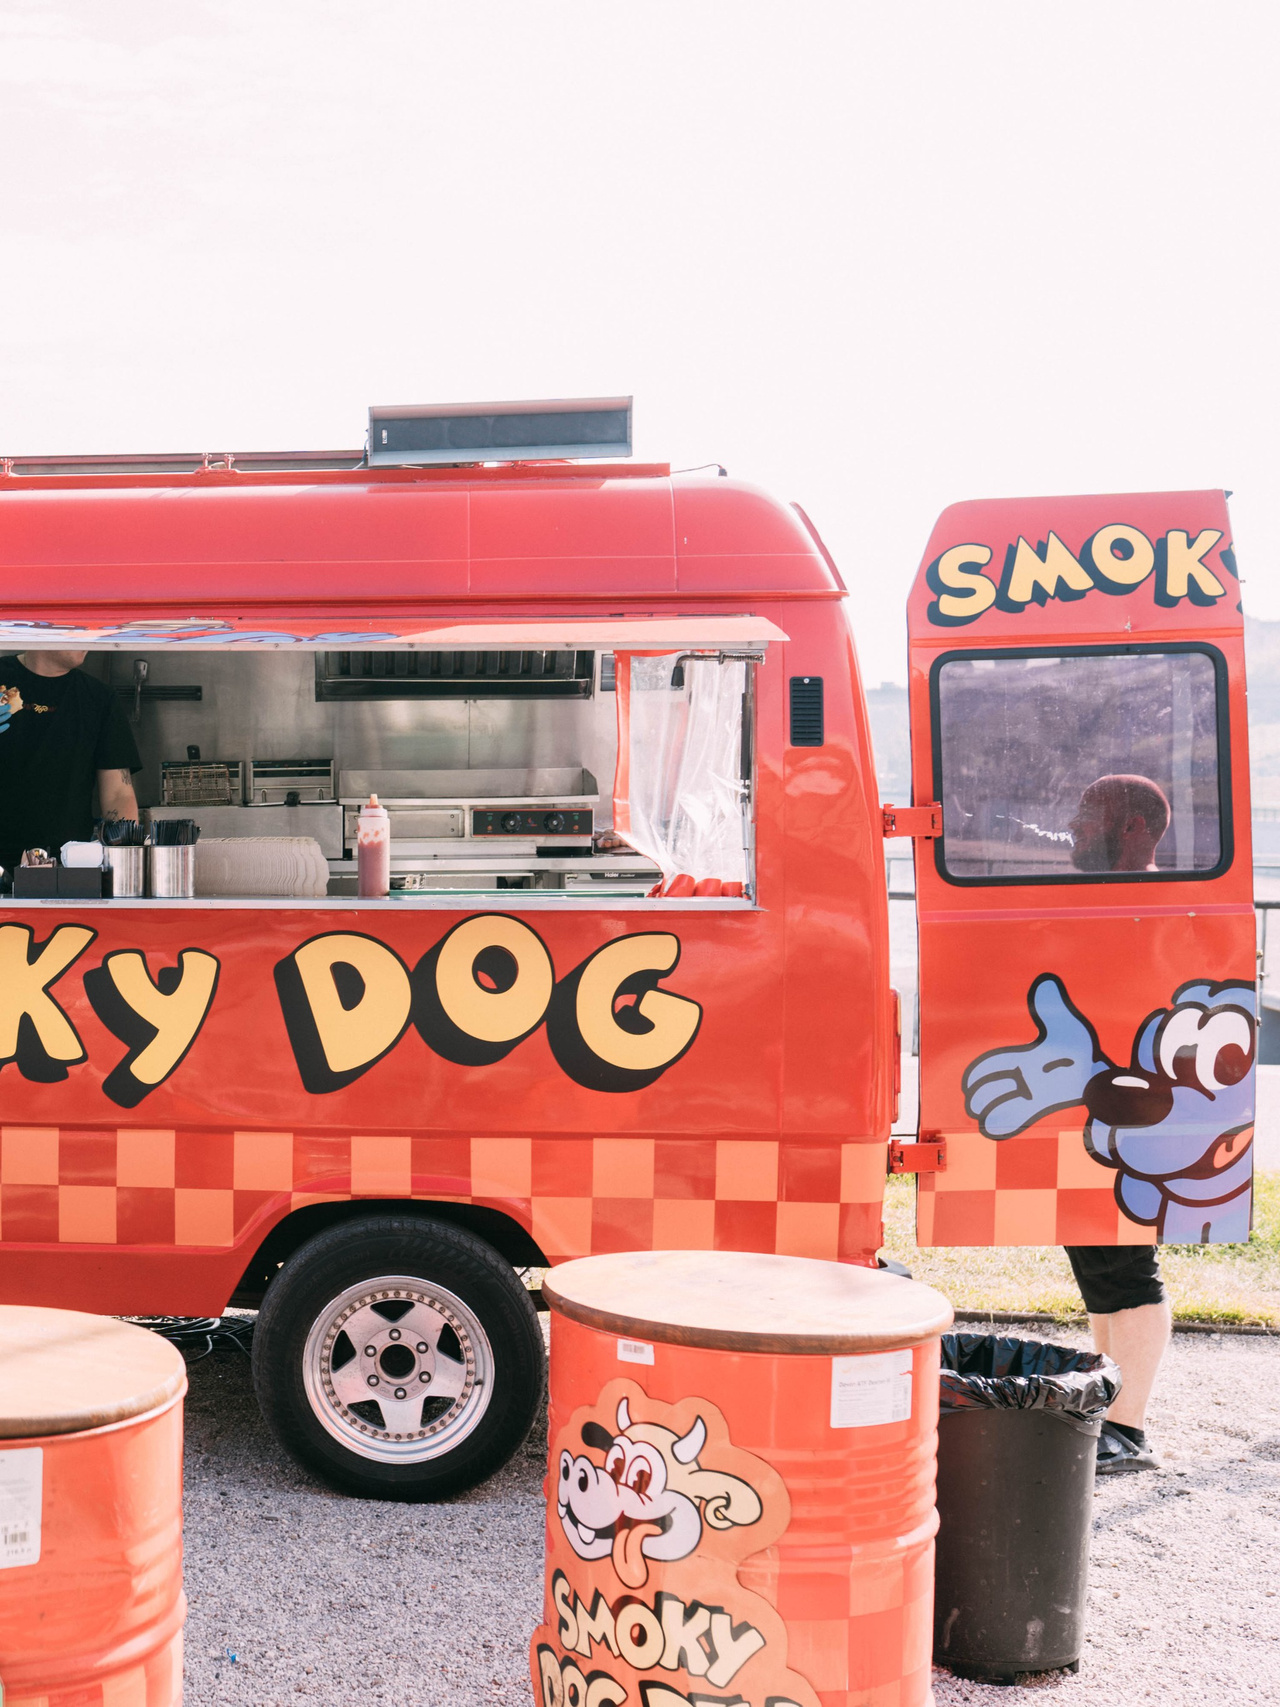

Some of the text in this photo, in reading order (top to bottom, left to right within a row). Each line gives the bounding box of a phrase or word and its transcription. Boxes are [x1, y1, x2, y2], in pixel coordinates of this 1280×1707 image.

[926, 522, 1243, 628] SMOK
[273, 912, 703, 1094] DOG
[551, 1568, 767, 1688] SMOKY
